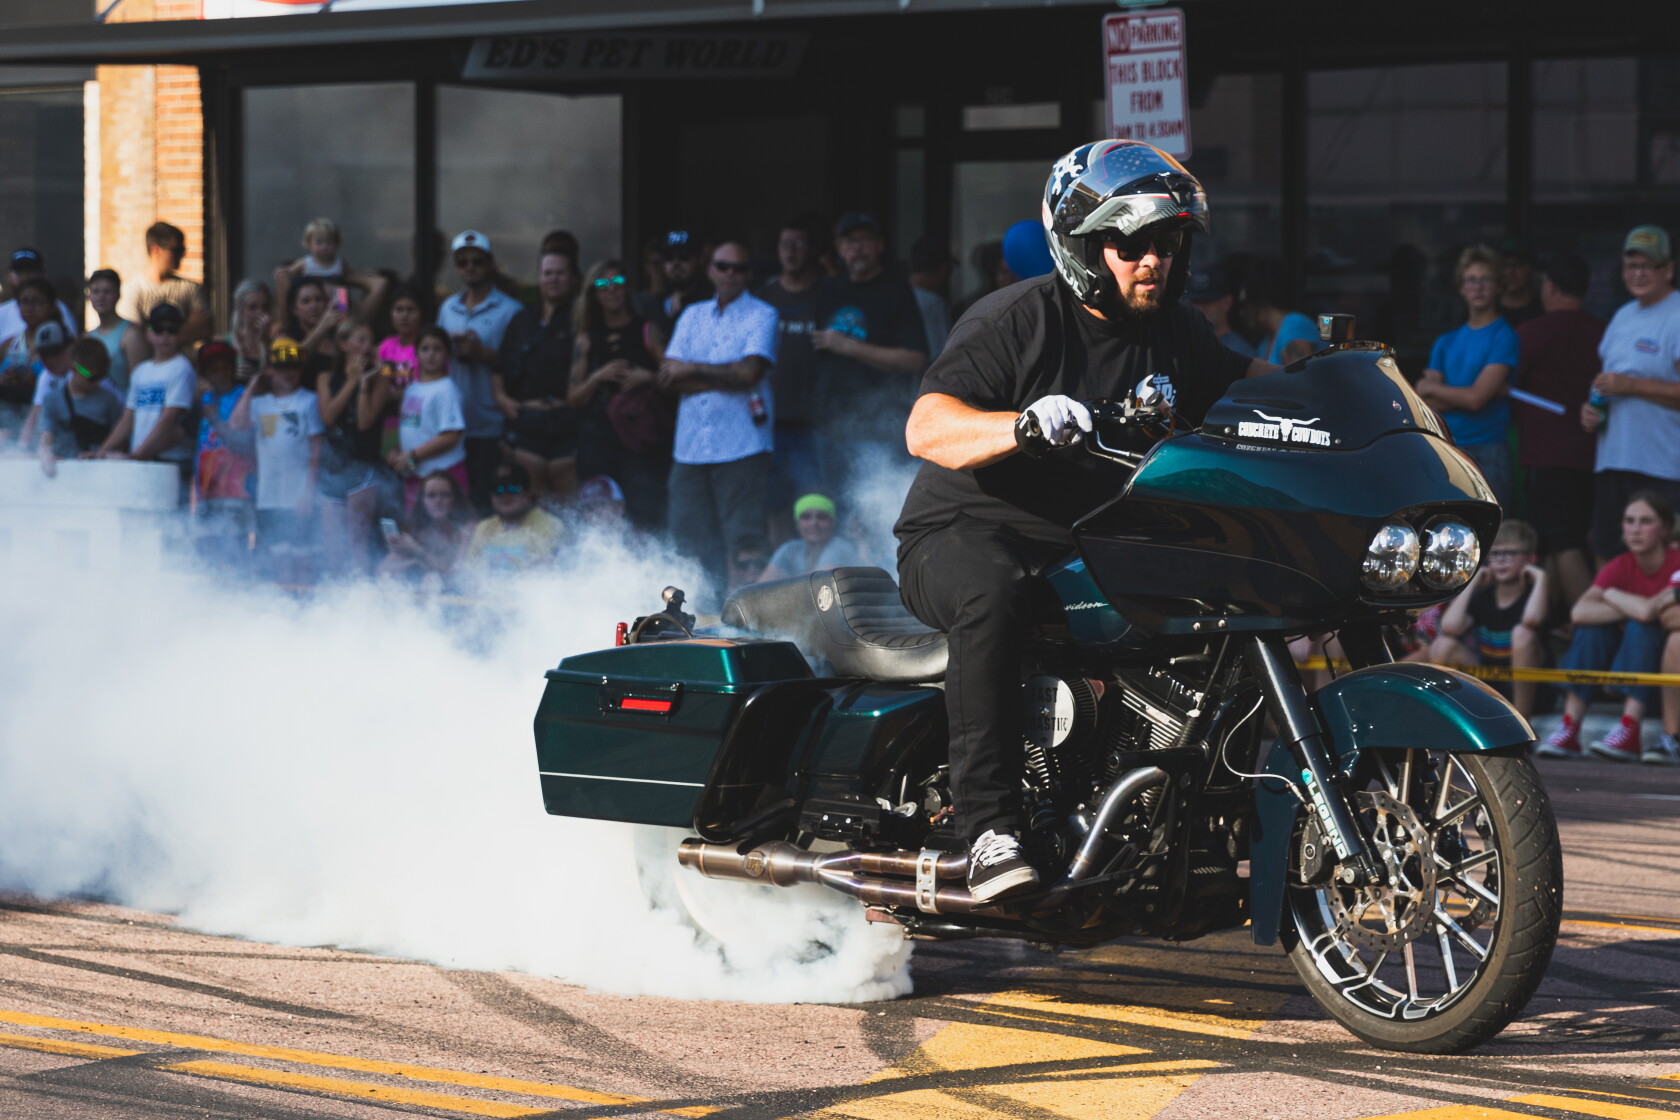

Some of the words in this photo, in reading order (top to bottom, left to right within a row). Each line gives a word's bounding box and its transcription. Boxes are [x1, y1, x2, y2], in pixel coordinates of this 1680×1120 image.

[1108, 21, 1130, 50] NO
[1131, 20, 1179, 43] PARKING
[485, 36, 569, 69] ED'S
[577, 37, 654, 69] PET
[664, 38, 786, 69] WORLD
[1110, 60, 1139, 85] THIS
[1141, 57, 1184, 83] BLOCK
[1130, 90, 1164, 114] FROM
[1238, 421, 1280, 439] CONCRETE
[1291, 426, 1331, 446] COWBOYS
[1307, 781, 1348, 860] LEGEND
